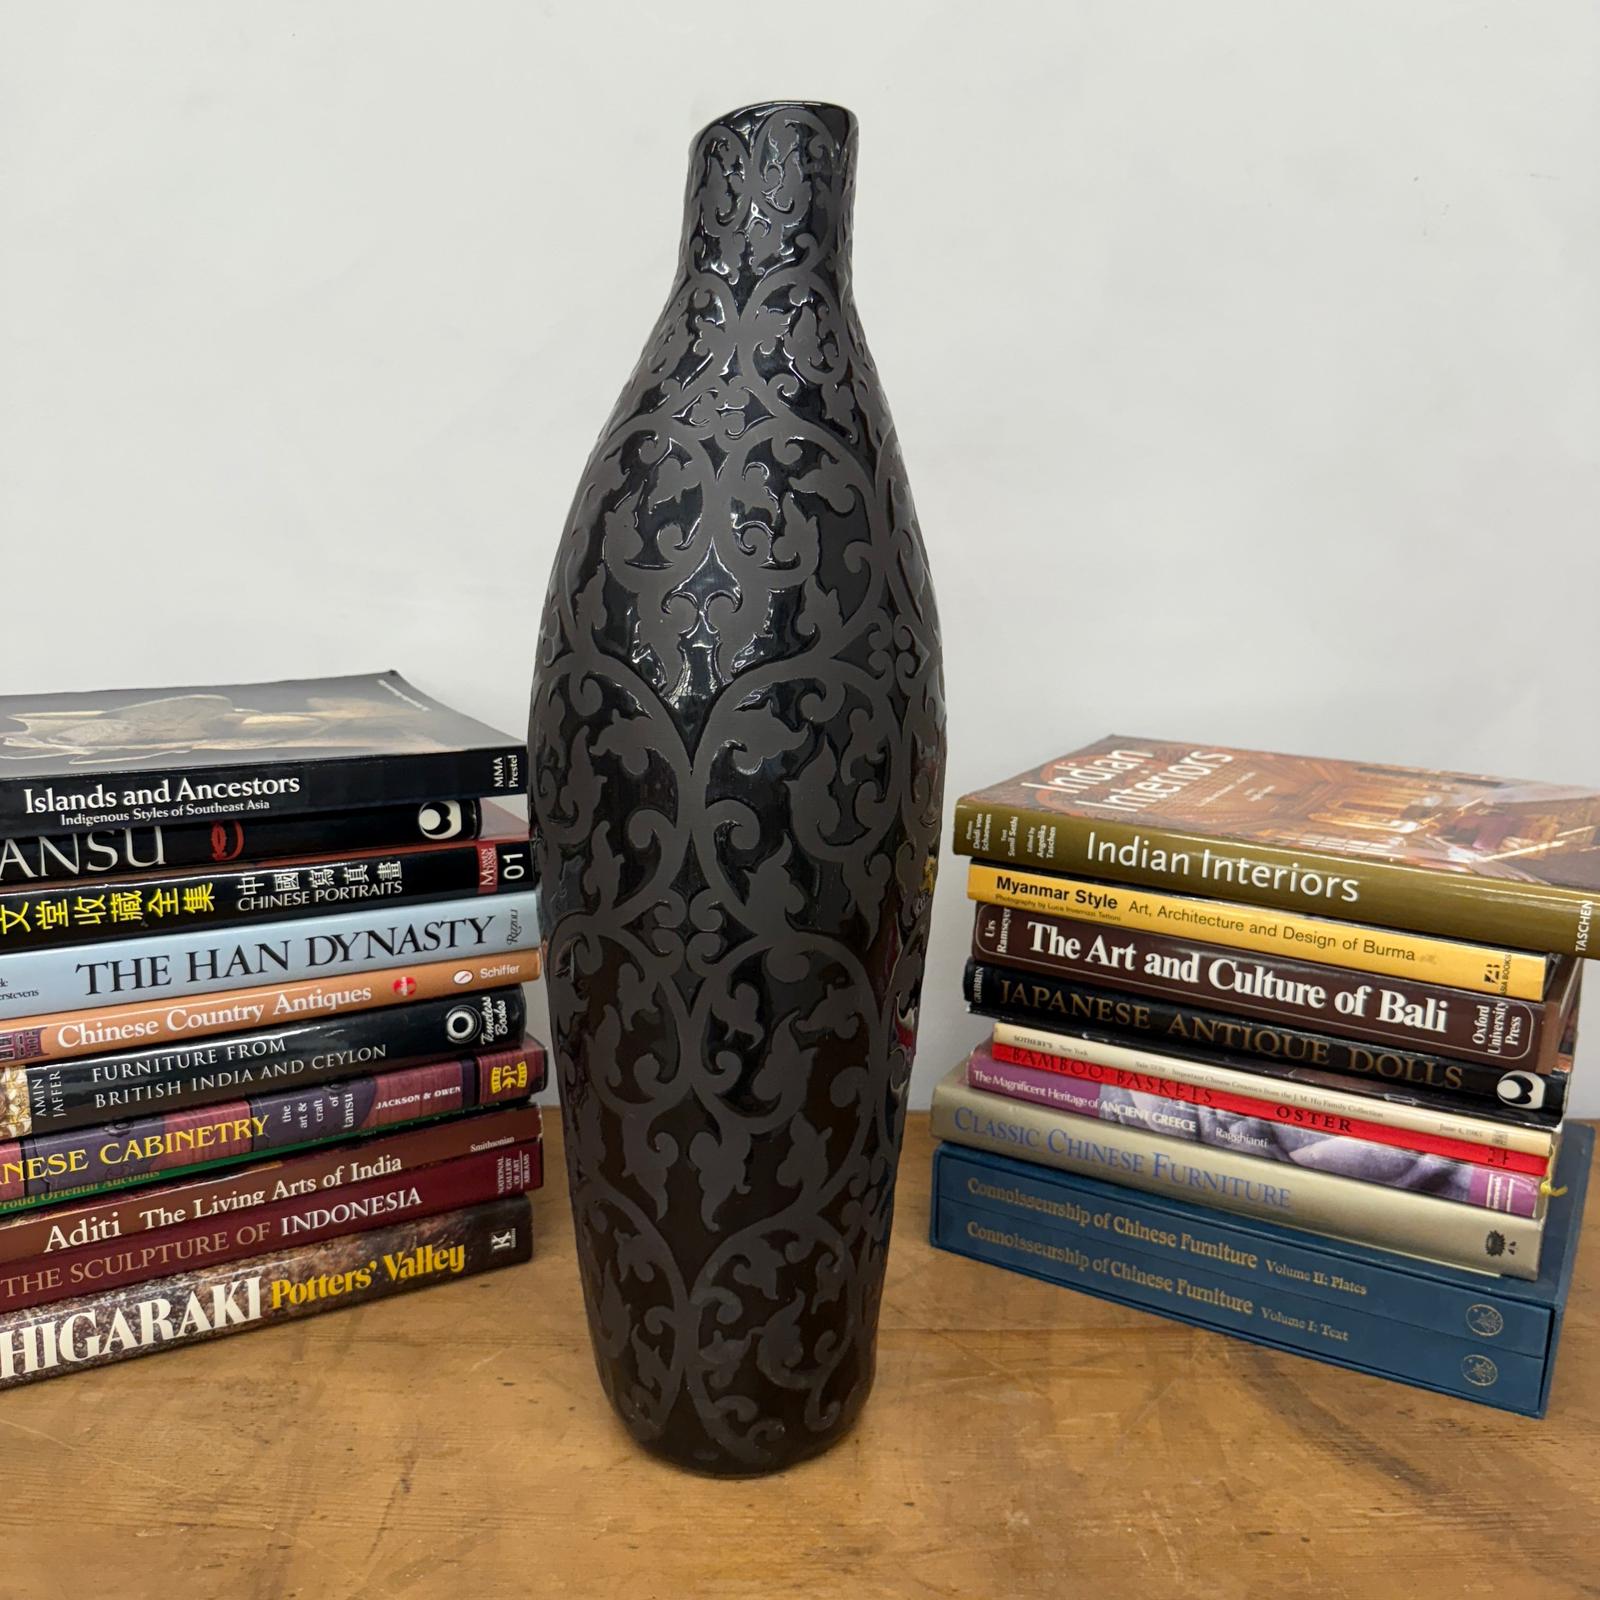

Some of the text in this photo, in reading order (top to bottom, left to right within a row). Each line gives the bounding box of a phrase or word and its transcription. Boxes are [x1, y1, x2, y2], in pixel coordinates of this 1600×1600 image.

[493, 757, 503, 788] MMA
[509, 755, 518, 788] Prestel
[1021, 749, 1154, 794] Indian
[1075, 750, 1234, 812] Interiors
[24, 777, 300, 814] Islands and Ancestors
[61, 799, 270, 827] Indigenous Styles of Southeast Asia
[0, 825, 166, 880] ANSU
[503, 853, 524, 880] 01
[1087, 830, 1360, 903] Indian Interiors
[238, 880, 403, 912] CHINESE PORTRAITS
[996, 875, 1416, 962] Myanmar Style Art, Architecture and Design of Burma
[984, 919, 996, 938] Urs
[997, 907, 1012, 954] Ramseyer
[1575, 899, 1593, 952] TASCHEN
[75, 915, 496, 996] THE HAN DYNASTY
[480, 964, 521, 979] Schiffer
[1027, 921, 1448, 1034] The Art and Culture of Bali
[57, 986, 372, 1049] Chinese Country Antiques
[481, 996, 492, 1046] Timeless
[495, 1000, 508, 1036] Books
[1000, 979, 1464, 1090] JAPANESE ANTIQUE DOLLS
[1472, 1005, 1490, 1045] Oxford
[1488, 1001, 1509, 1054] University
[1505, 1016, 1521, 1046] Press
[93, 1037, 286, 1083] FURNITURE FROM
[95, 1045, 387, 1109] BRITISH INDIA AND CEYLON
[1012, 1046, 1212, 1104] BAMBOO BASKETS
[32, 1077, 47, 1117] AMIN
[51, 1070, 66, 1118] JAFFER
[282, 1104, 291, 1123] the
[300, 1101, 308, 1129] art &
[315, 1097, 324, 1122] craft
[330, 1094, 339, 1107] of
[344, 1093, 354, 1128] tansu
[376, 1086, 461, 1110] JACKSON & OWEN
[974, 1070, 1197, 1132] The Magnificent Heritage of ANCIENT GREECE
[99, 1114, 270, 1165] CABINETRY
[1275, 1104, 1352, 1133] OSTER
[469, 1136, 515, 1153] Smithsonian
[954, 1106, 1292, 1208] CLASSIC CHINESE FURNITURE
[43, 1153, 403, 1253] Aditi The Living Arts of India
[1, 1187, 423, 1298] THE SCULPTURE OF INDONESIA
[967, 1177, 1368, 1296] Connoisseurship of Chinese Furniture Volume II: Plates
[966, 1221, 1089, 1272] Connoisseurship
[1092, 1257, 1111, 1275] of
[1110, 1261, 1173, 1292] Chinese
[1176, 1279, 1254, 1314] Furniture
[1260, 1306, 1306, 1329] Volume
[1320, 1322, 1349, 1342] Text
[0, 1244, 465, 1380] HIGARAKI Potters' Valley
